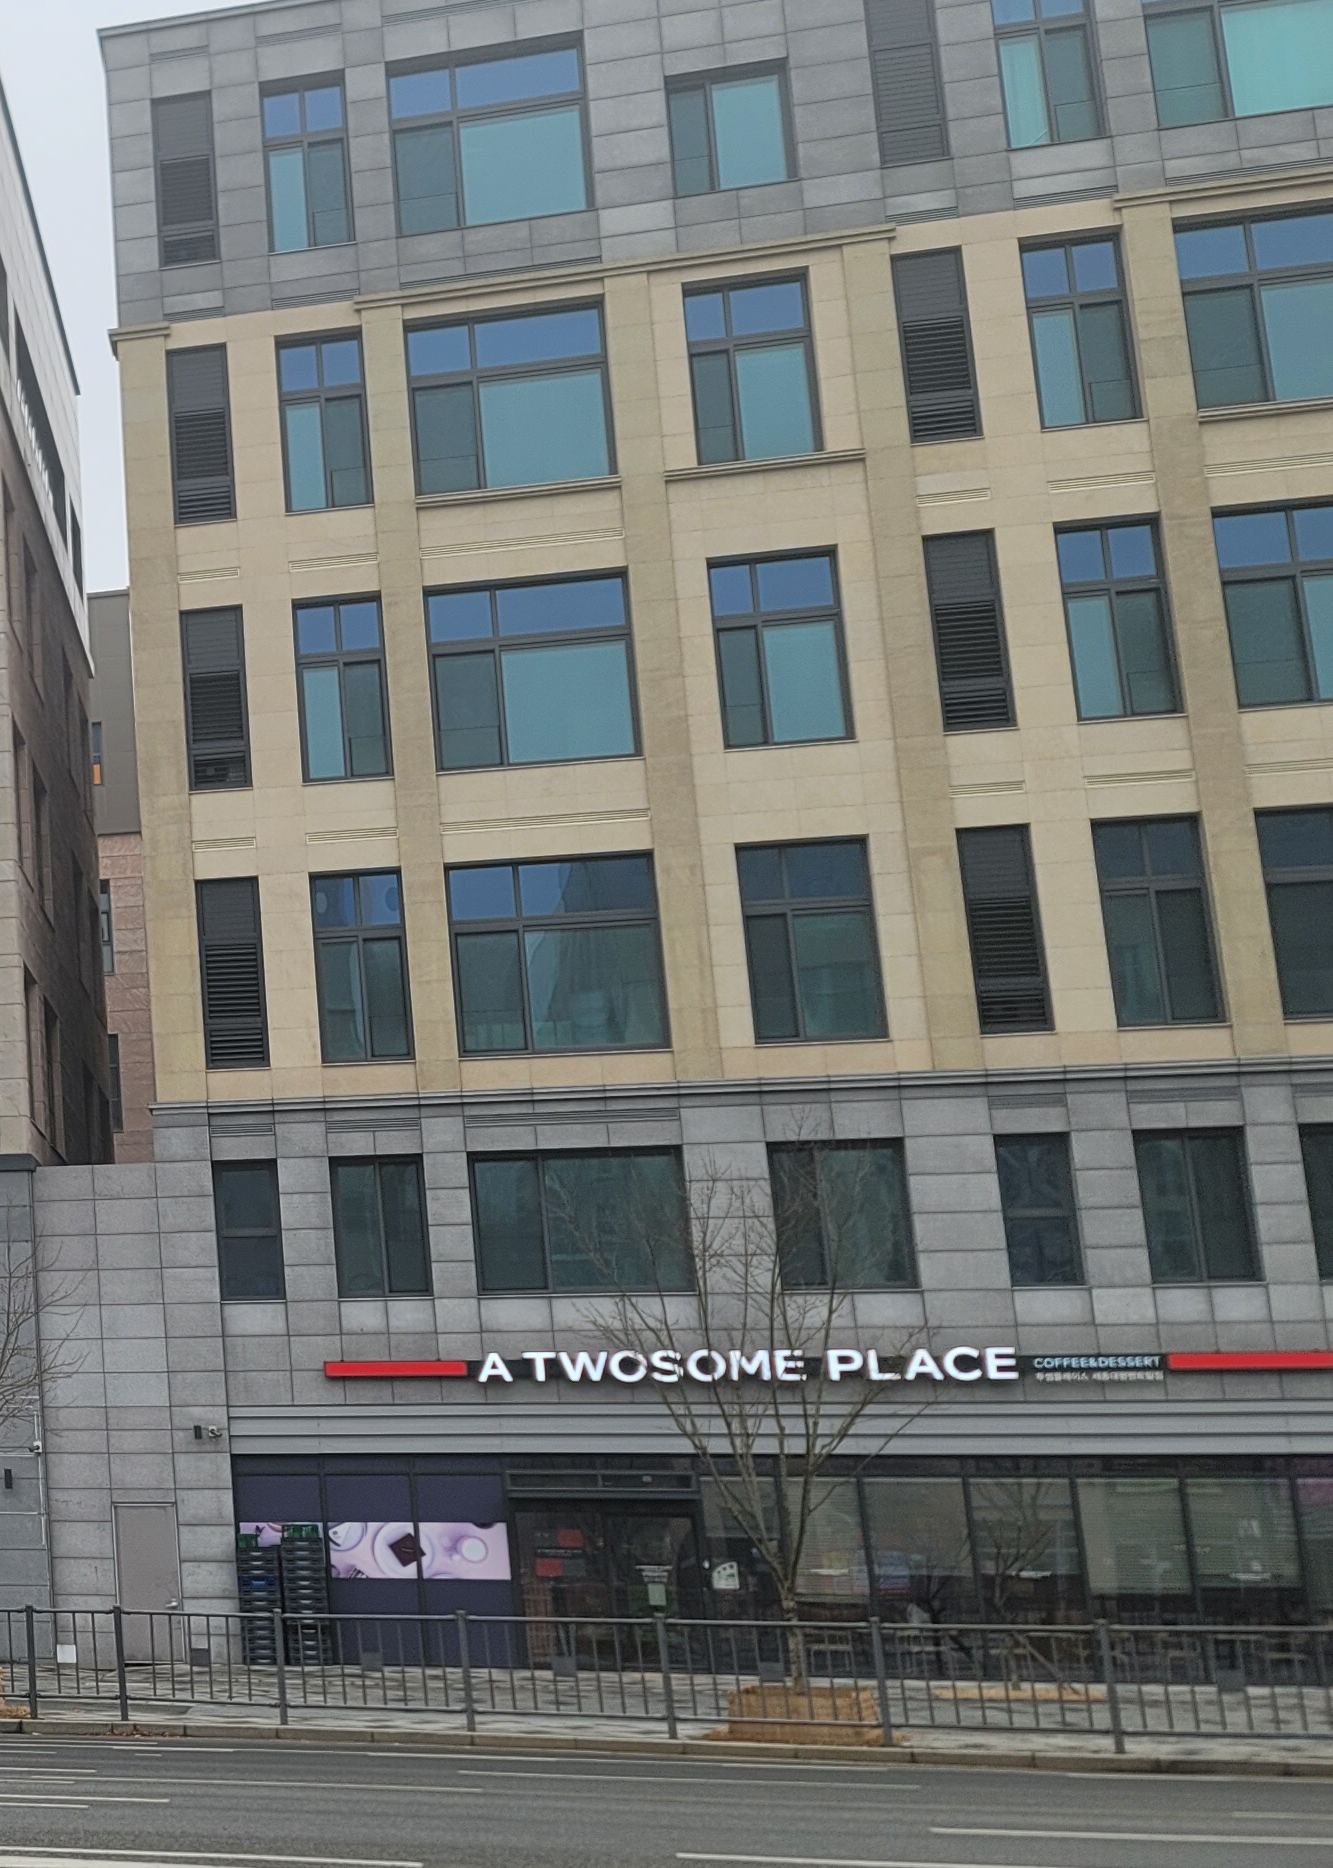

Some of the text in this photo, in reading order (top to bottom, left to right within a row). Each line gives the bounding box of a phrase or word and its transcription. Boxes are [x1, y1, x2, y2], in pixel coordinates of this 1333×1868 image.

[478, 1346, 1019, 1383] A TWOSOME PLACE
[1034, 1356, 1161, 1369] COFFEE&DESSERT
